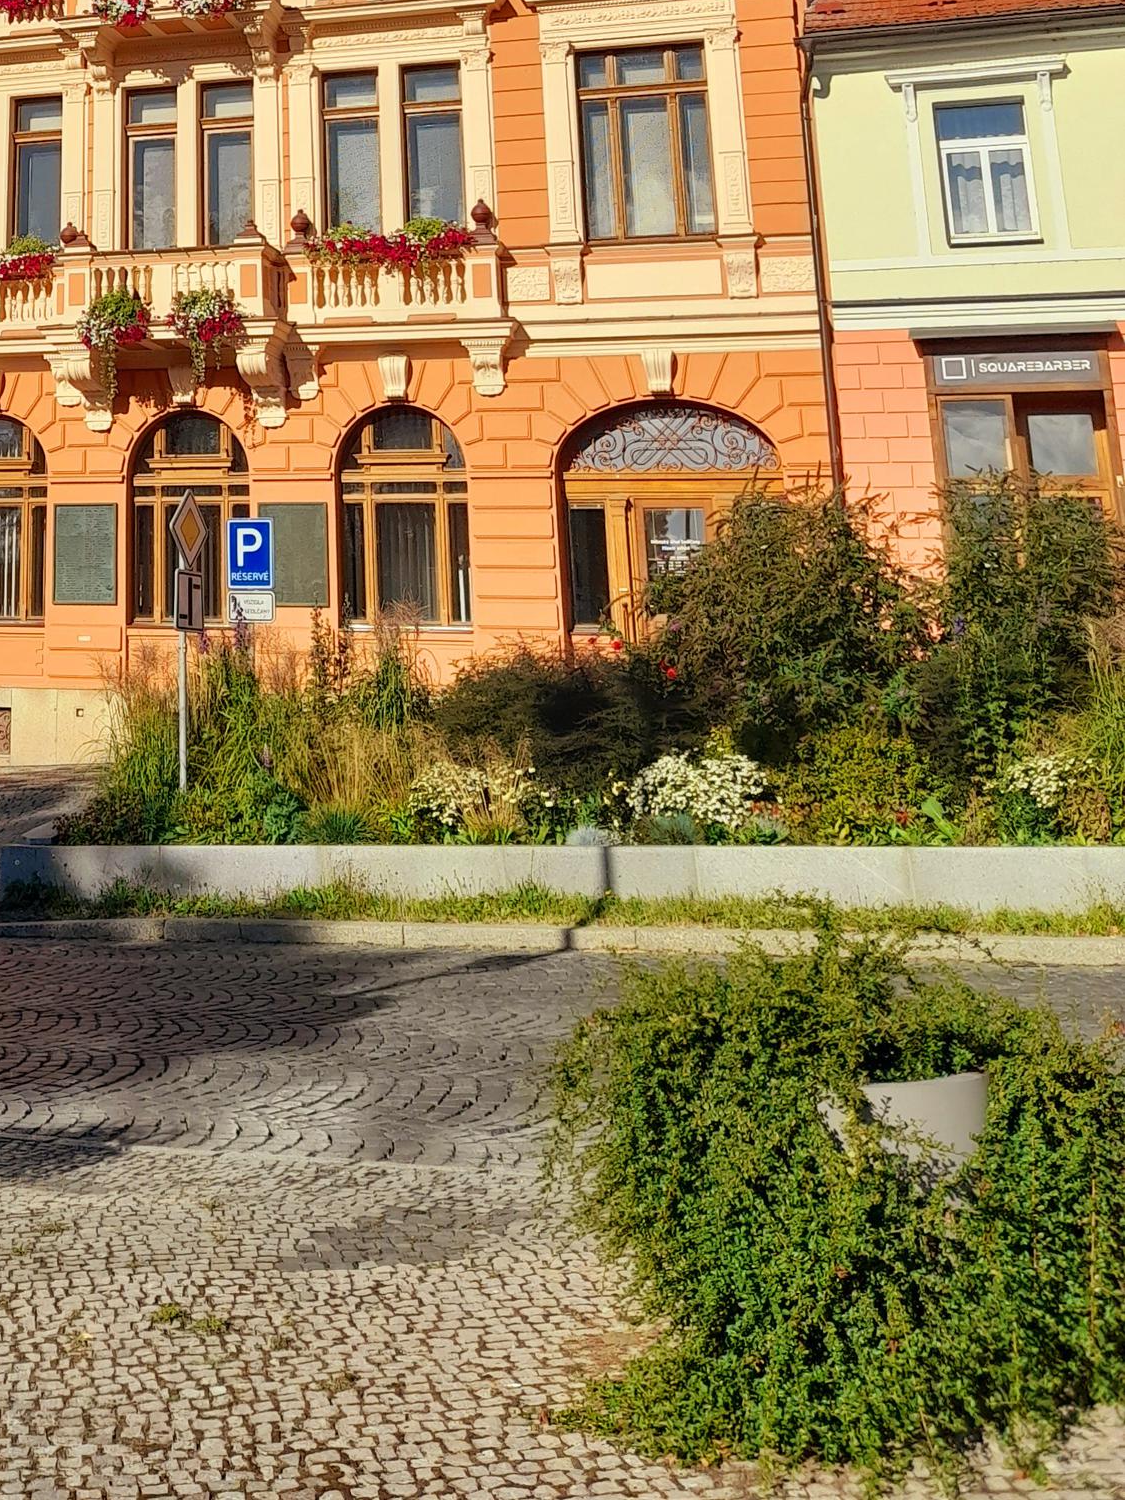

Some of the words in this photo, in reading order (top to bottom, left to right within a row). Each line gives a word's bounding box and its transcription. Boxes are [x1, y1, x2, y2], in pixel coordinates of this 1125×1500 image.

[978, 359, 1091, 373] SQUAREBARBER
[236, 527, 263, 567] P
[231, 570, 269, 581] RÉSERVÉ
